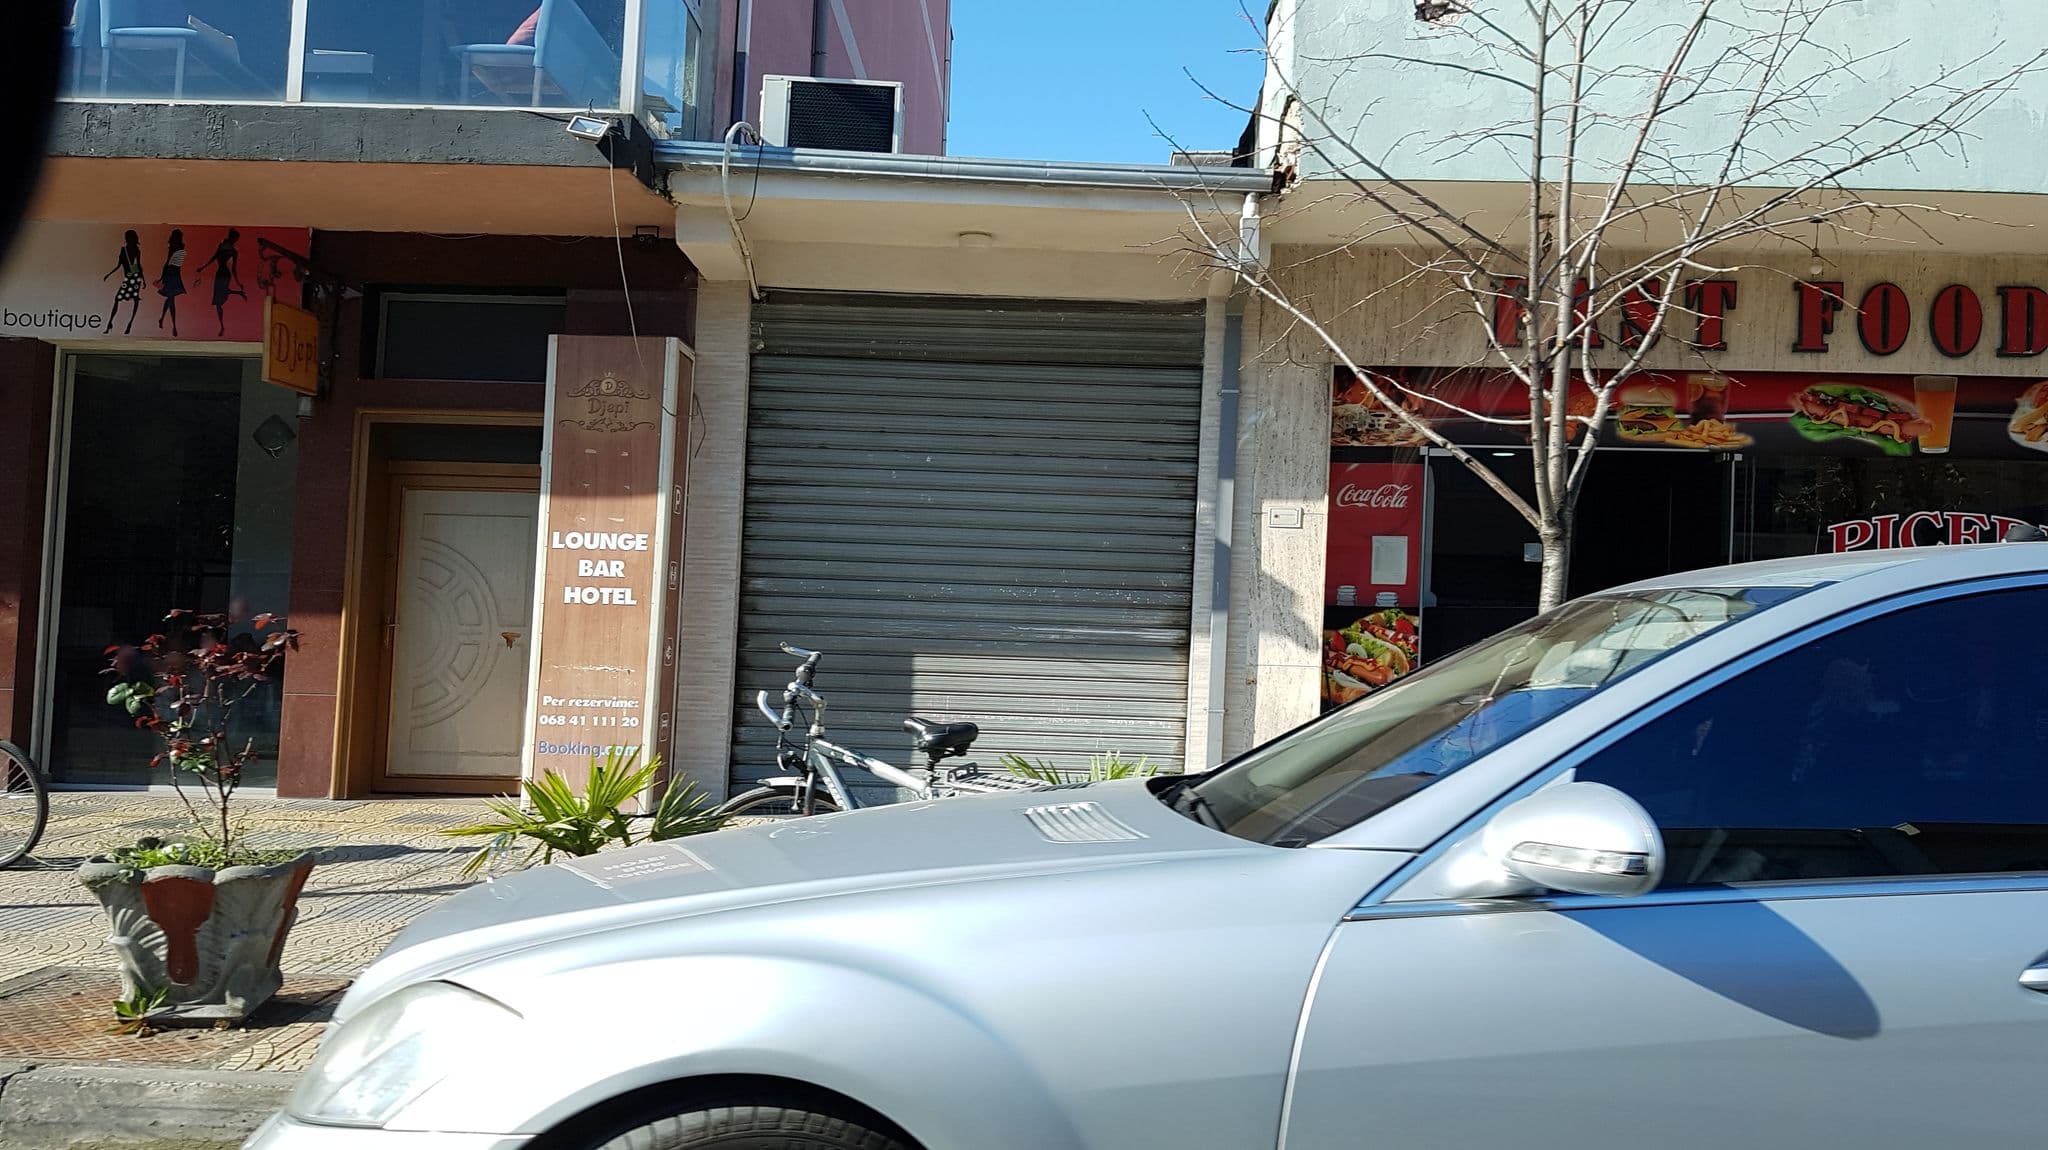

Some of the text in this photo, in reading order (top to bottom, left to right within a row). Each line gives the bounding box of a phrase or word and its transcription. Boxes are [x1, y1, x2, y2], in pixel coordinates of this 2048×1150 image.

[3, 308, 102, 331] boutique
[1489, 277, 2048, 358] FAST FOOD
[271, 321, 317, 372] Djepi
[588, 399, 629, 417] Djepi
[551, 531, 648, 550] LOUNGE
[1828, 511, 2048, 553] PICE
[578, 559, 625, 578] BAR
[563, 586, 637, 605] HOTEL
[542, 695, 639, 708] Per rezervime:
[539, 715, 639, 727] 068 41 111 20
